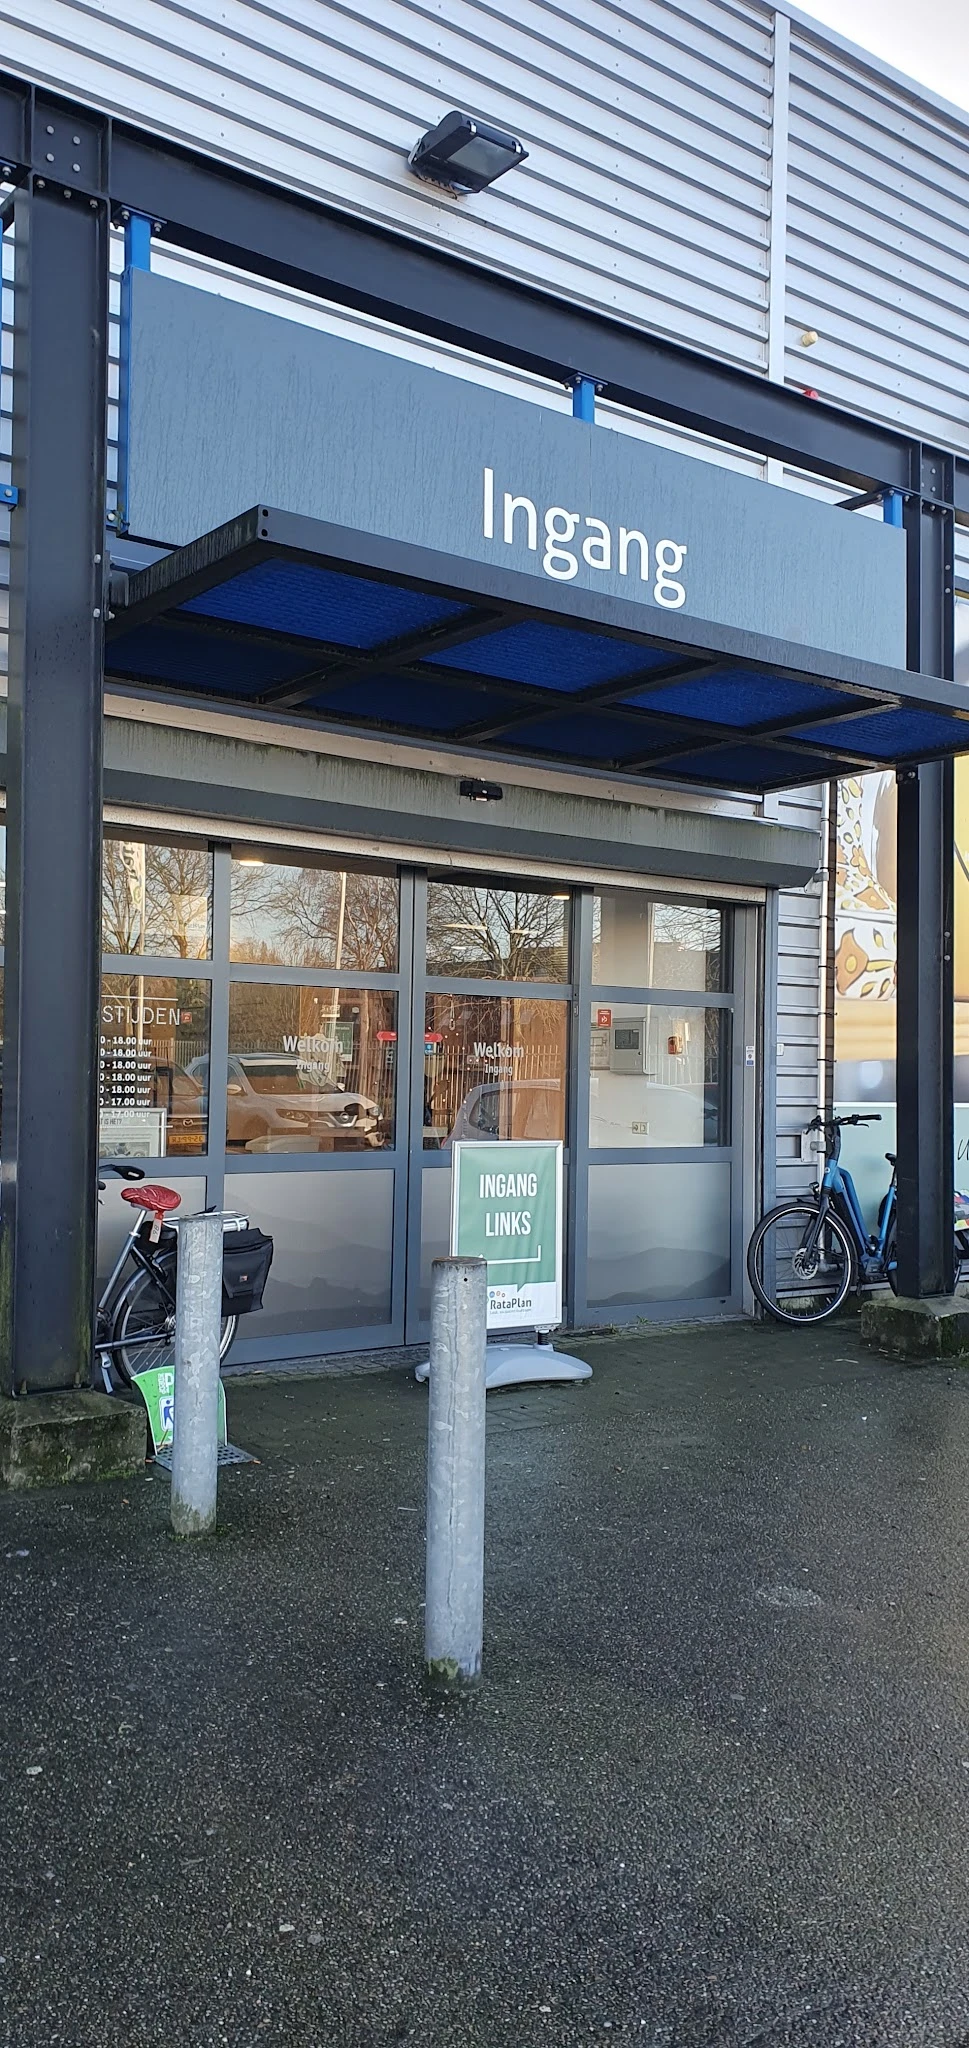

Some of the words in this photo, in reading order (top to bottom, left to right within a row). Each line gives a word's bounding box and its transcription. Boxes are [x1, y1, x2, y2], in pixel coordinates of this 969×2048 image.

[484, 468, 687, 609] Ingang
[102, 1005, 180, 1025] STIJDEN
[112, 1036, 136, 1044] 18.00
[283, 1034, 344, 1053] Welkom
[112, 1049, 136, 1057] 18.00
[474, 1042, 524, 1058] Welkom
[112, 1061, 136, 1069] 18.00
[296, 1060, 331, 1073] Ingang
[484, 1064, 513, 1076] Ingang
[112, 1073, 136, 1081] 18.00
[111, 1098, 136, 1106] 17.00
[111, 1110, 135, 1118] 17.00
[479, 1173, 538, 1198] INGANG
[485, 1211, 532, 1237] LINKS
[490, 1298, 532, 1310] RataPlan
